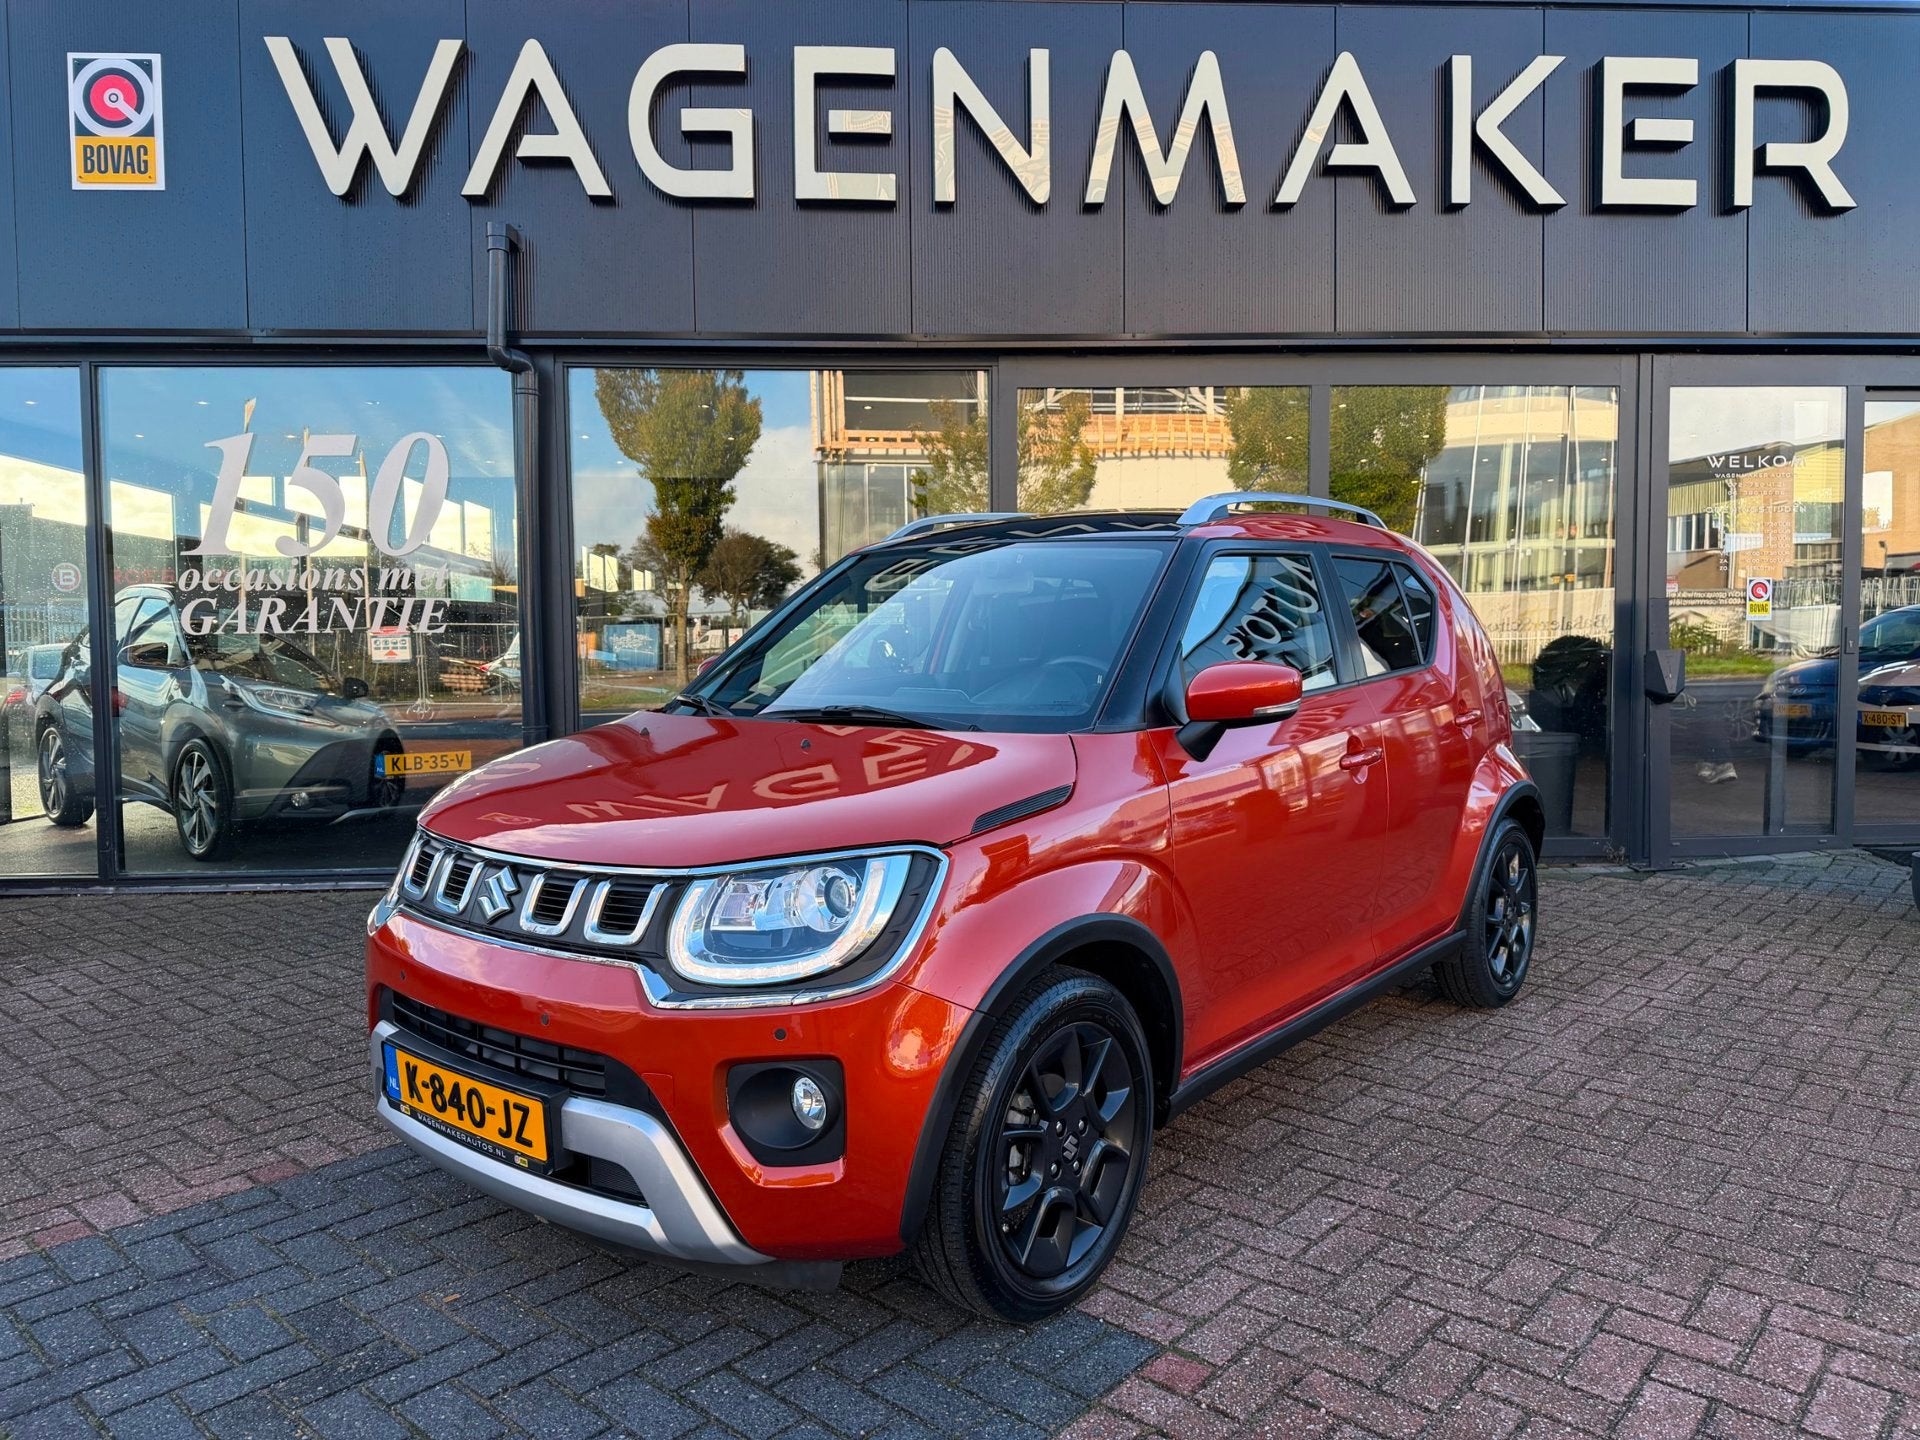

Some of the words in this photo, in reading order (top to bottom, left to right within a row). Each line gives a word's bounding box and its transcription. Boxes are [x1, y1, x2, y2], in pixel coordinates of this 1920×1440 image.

[264, 36, 1858, 209] WAGENMAKER
[82, 143, 149, 175] BOVAG
[180, 431, 450, 556] 150
[178, 558, 366, 592] occasions
[378, 563, 449, 592] met
[181, 597, 452, 635] GARANTIE
[1749, 602, 1769, 613] BOVAG
[1863, 713, 1903, 726] X-480-ST
[391, 753, 465, 772] KLB-35-V
[389, 1076, 399, 1091] NL
[405, 1060, 533, 1148] K-840-JZ
[417, 1112, 506, 1159] WAGENMAKERAUTOS.NL
